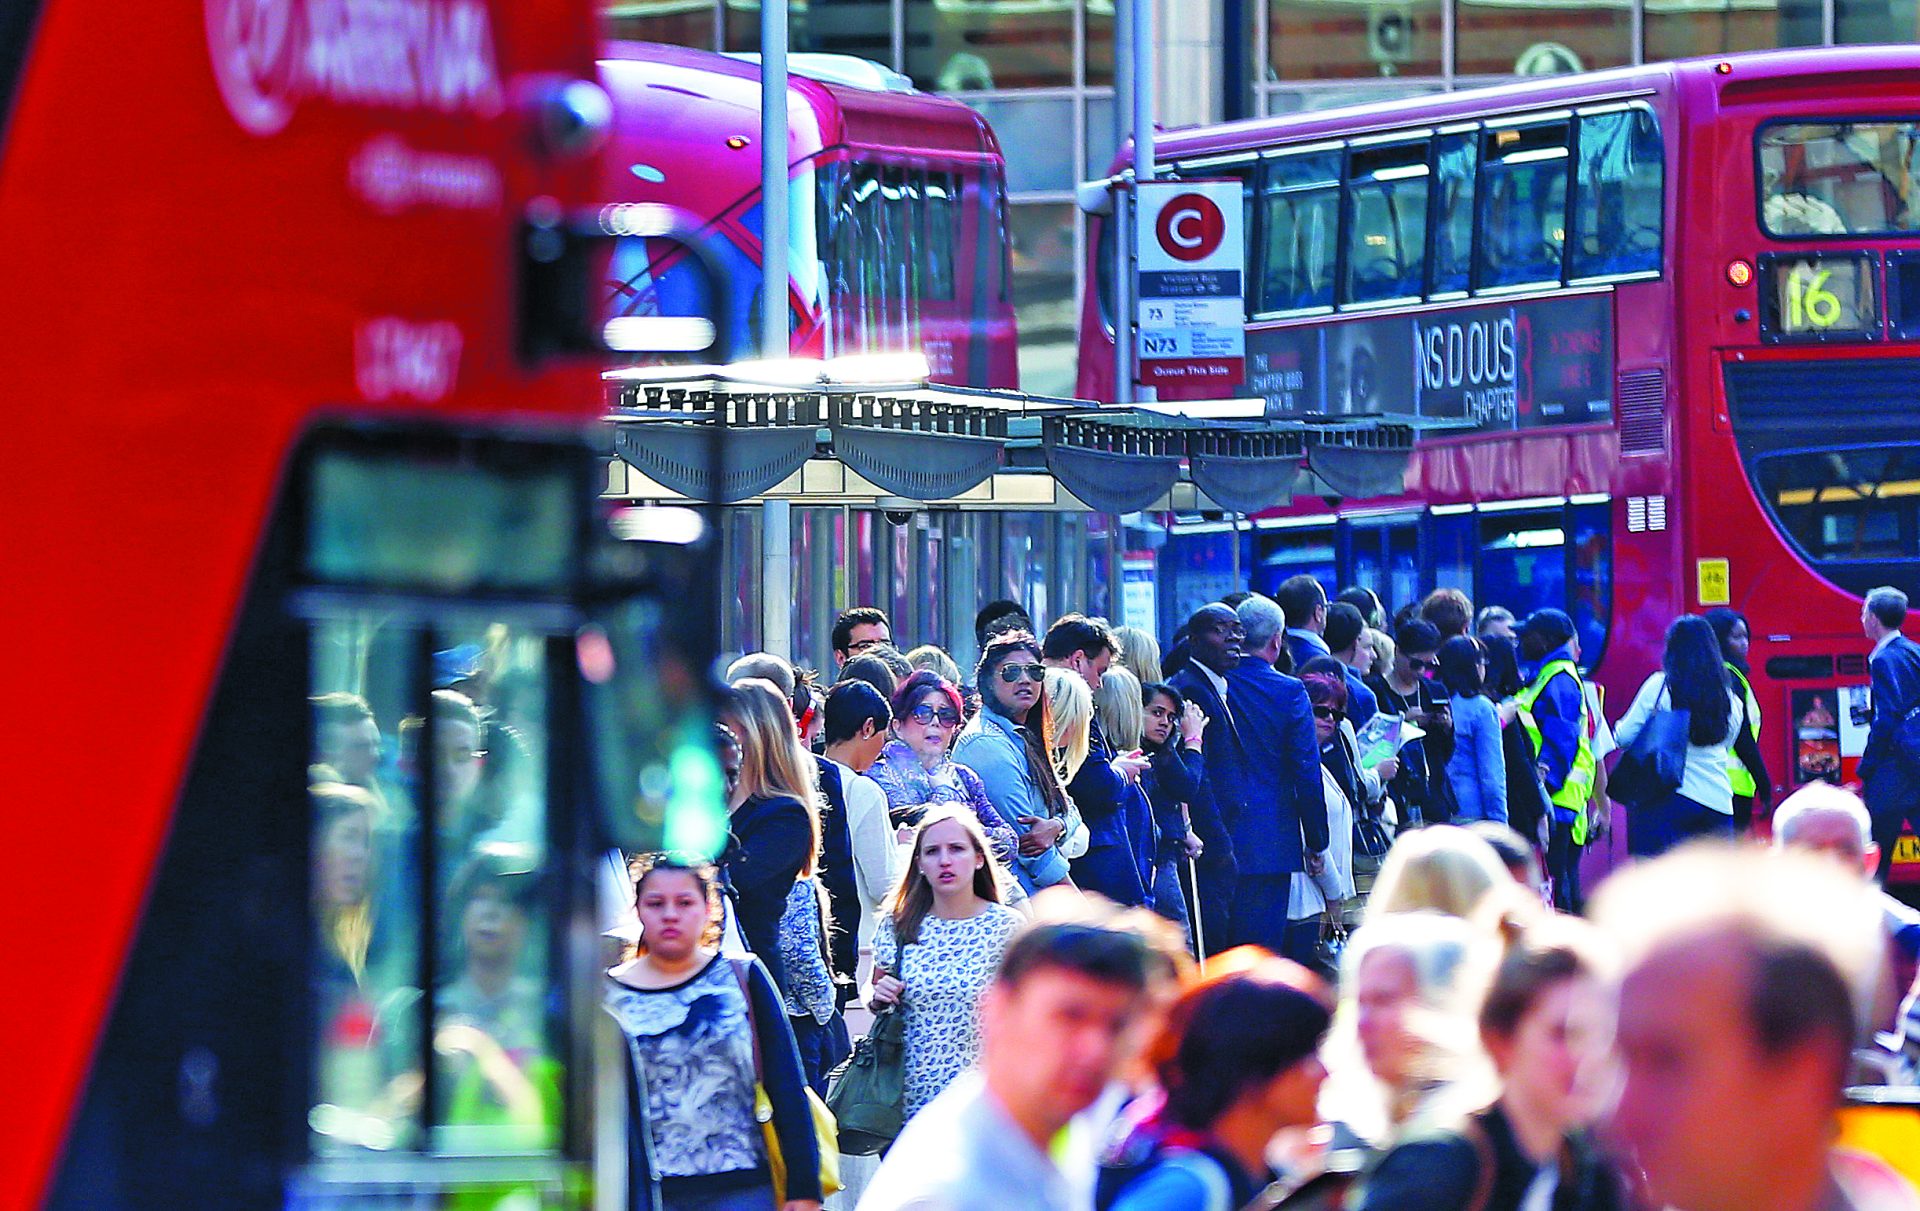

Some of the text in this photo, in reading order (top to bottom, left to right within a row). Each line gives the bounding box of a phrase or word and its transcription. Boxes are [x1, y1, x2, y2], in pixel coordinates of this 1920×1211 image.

[1169, 208, 1203, 249] C
[1149, 308, 1164, 320] 73
[1787, 268, 1841, 327] 16
[1144, 338, 1178, 352] N73
[1463, 386, 1515, 421] CHAPTER
